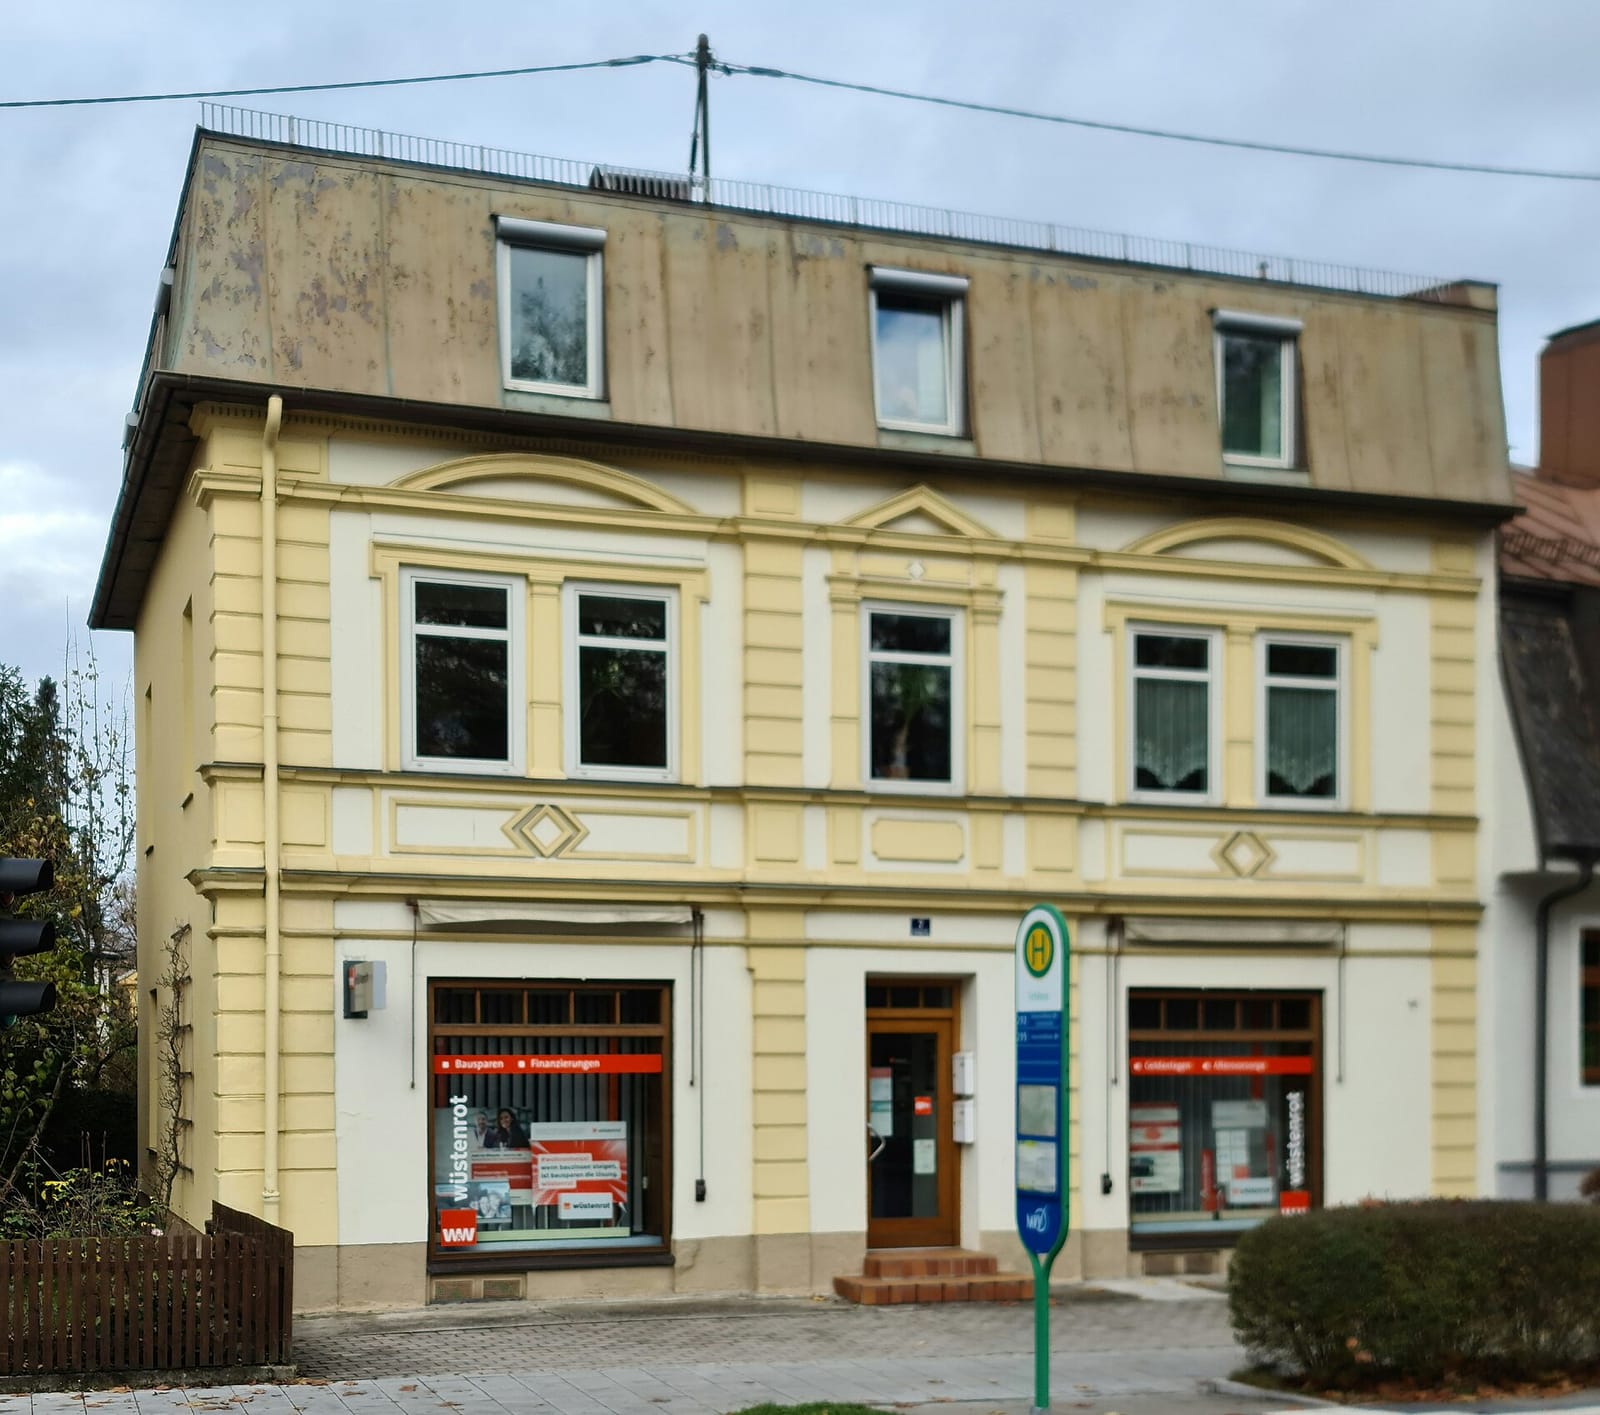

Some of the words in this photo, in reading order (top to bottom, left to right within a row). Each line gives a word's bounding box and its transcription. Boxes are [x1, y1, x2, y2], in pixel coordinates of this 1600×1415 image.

[1032, 934, 1045, 965] H
[455, 1059, 504, 1070] Bausparen
[530, 1058, 601, 1070] Finanzierungen
[449, 1094, 469, 1202] wüstenrot
[573, 1201, 611, 1209] wüstenrot
